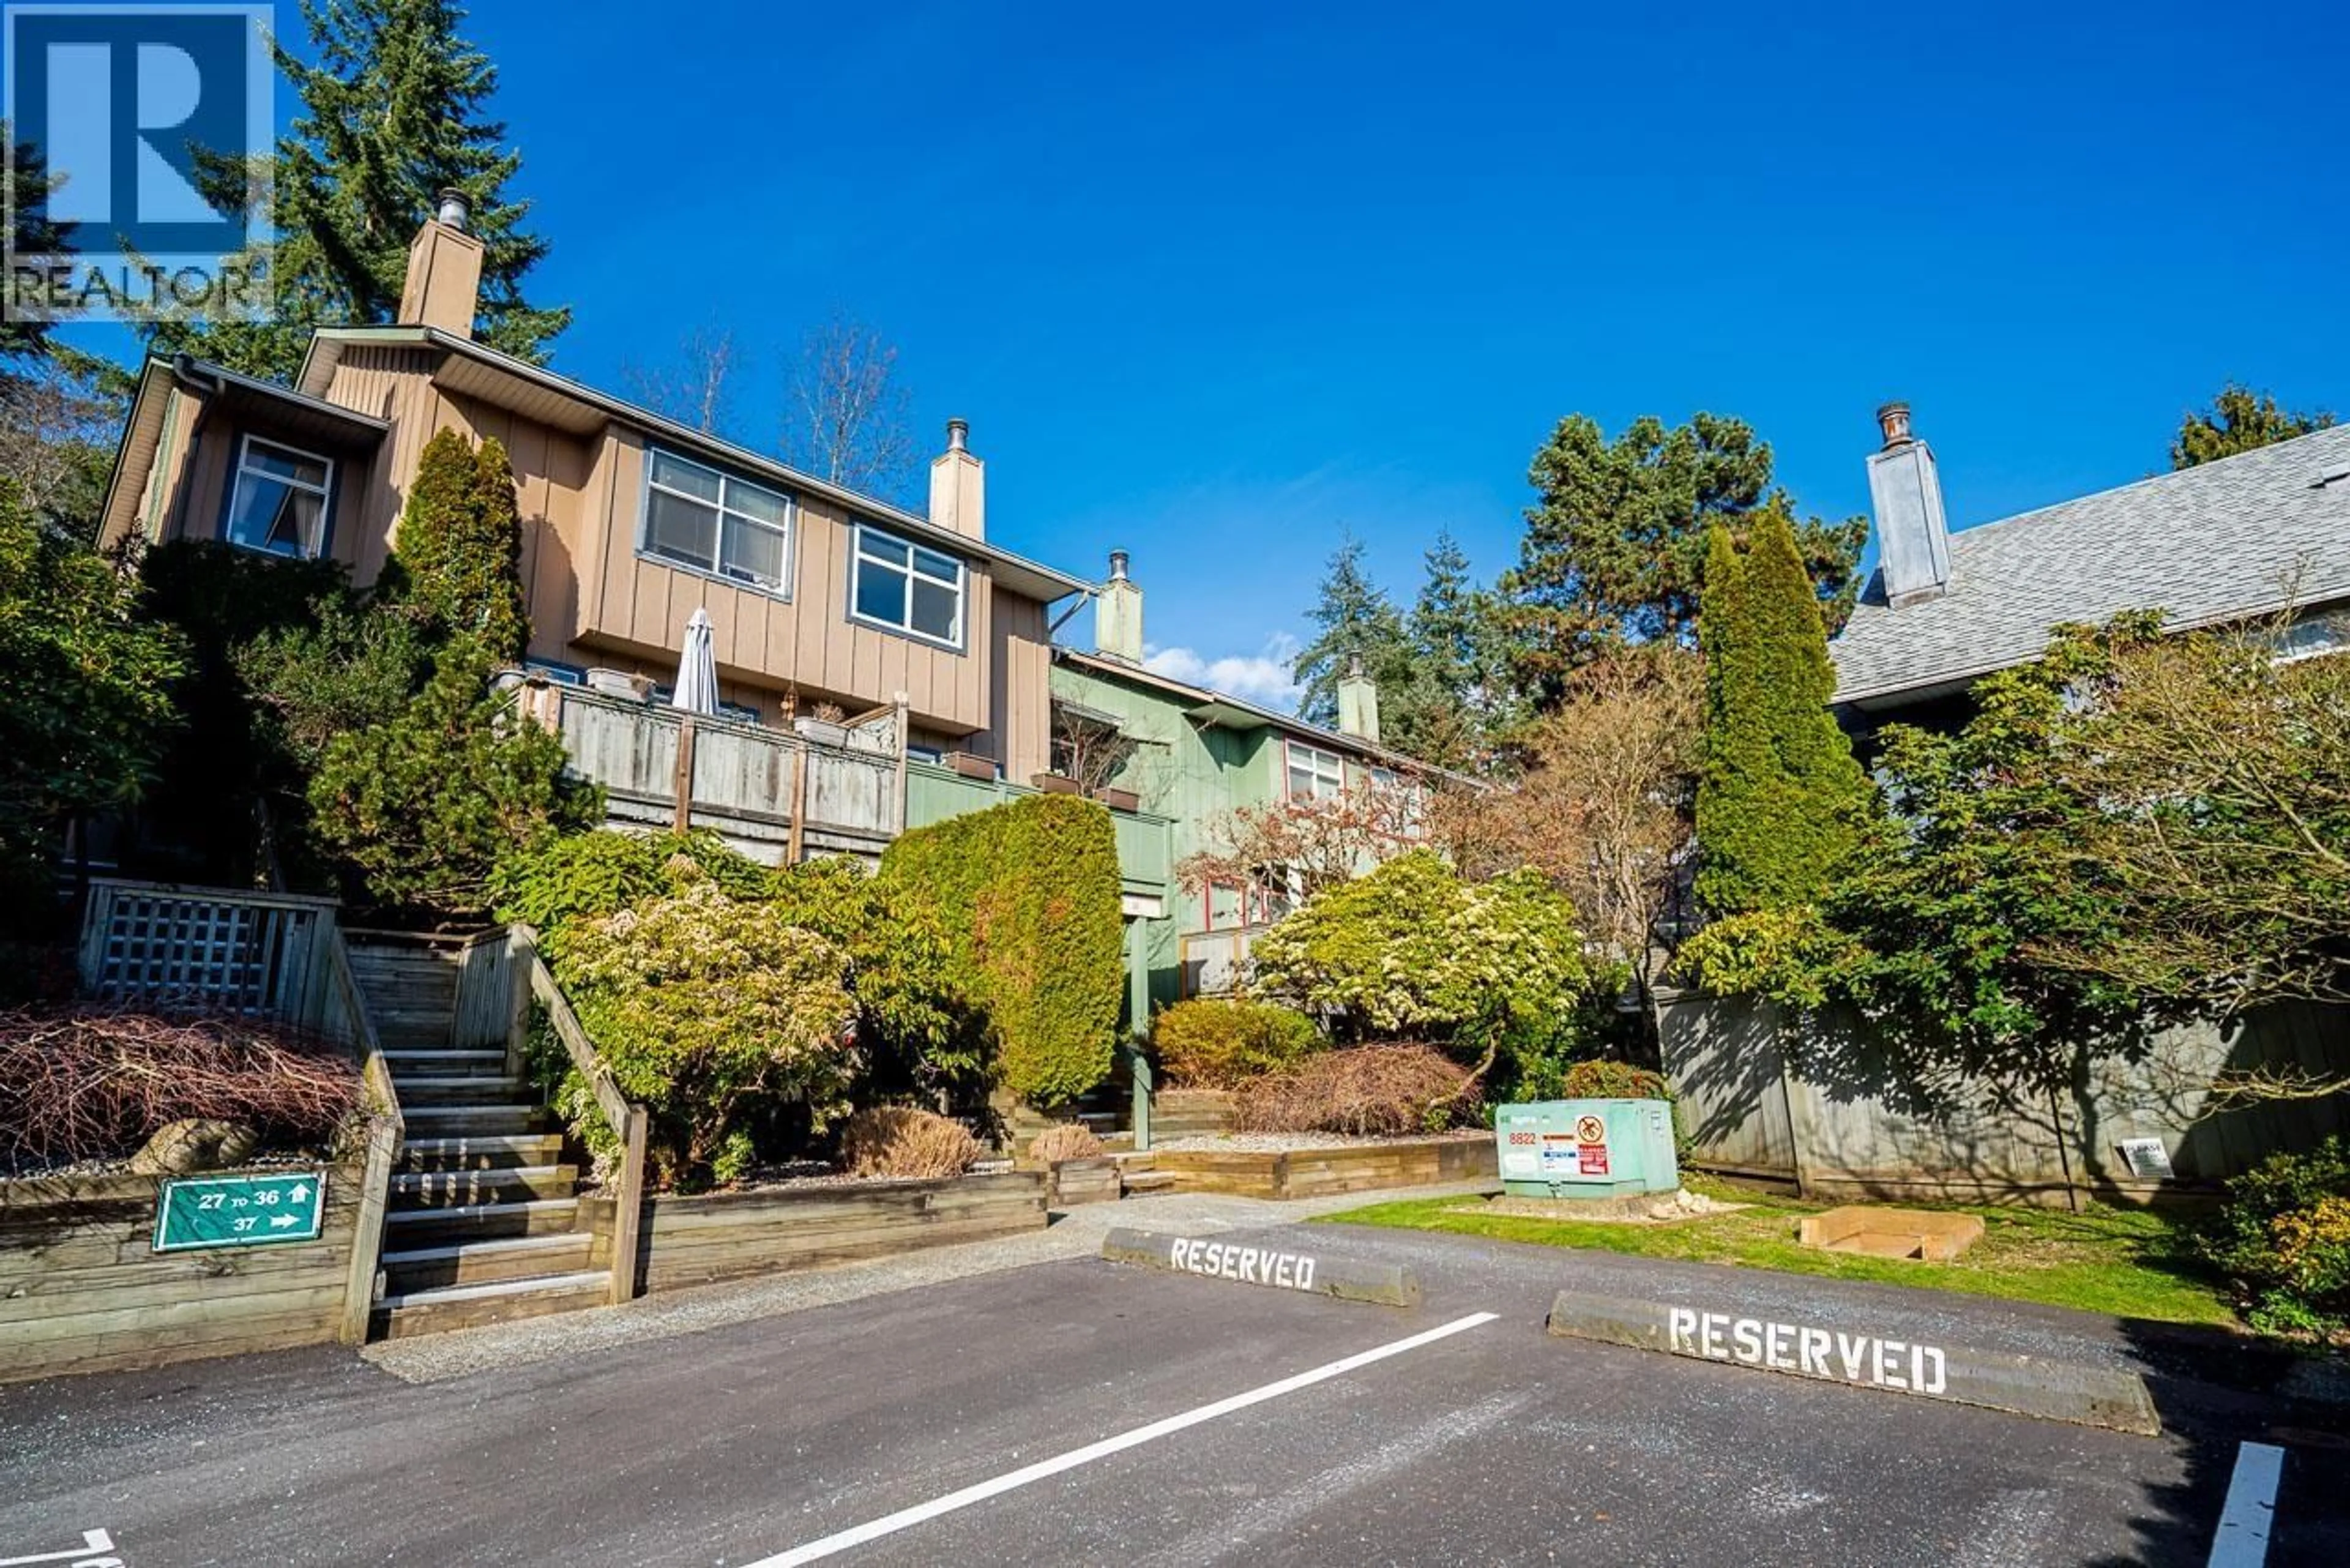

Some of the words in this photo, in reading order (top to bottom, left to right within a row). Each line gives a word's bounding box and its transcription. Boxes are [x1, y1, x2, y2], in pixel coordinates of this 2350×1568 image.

[1509, 1133, 1535, 1144] 8822
[198, 1193, 226, 1209] 27
[253, 1189, 280, 1206] 36
[233, 1215, 259, 1231] 37
[1171, 1238, 1316, 1290] RESERVED
[1669, 1307, 1947, 1395] RESERVED
